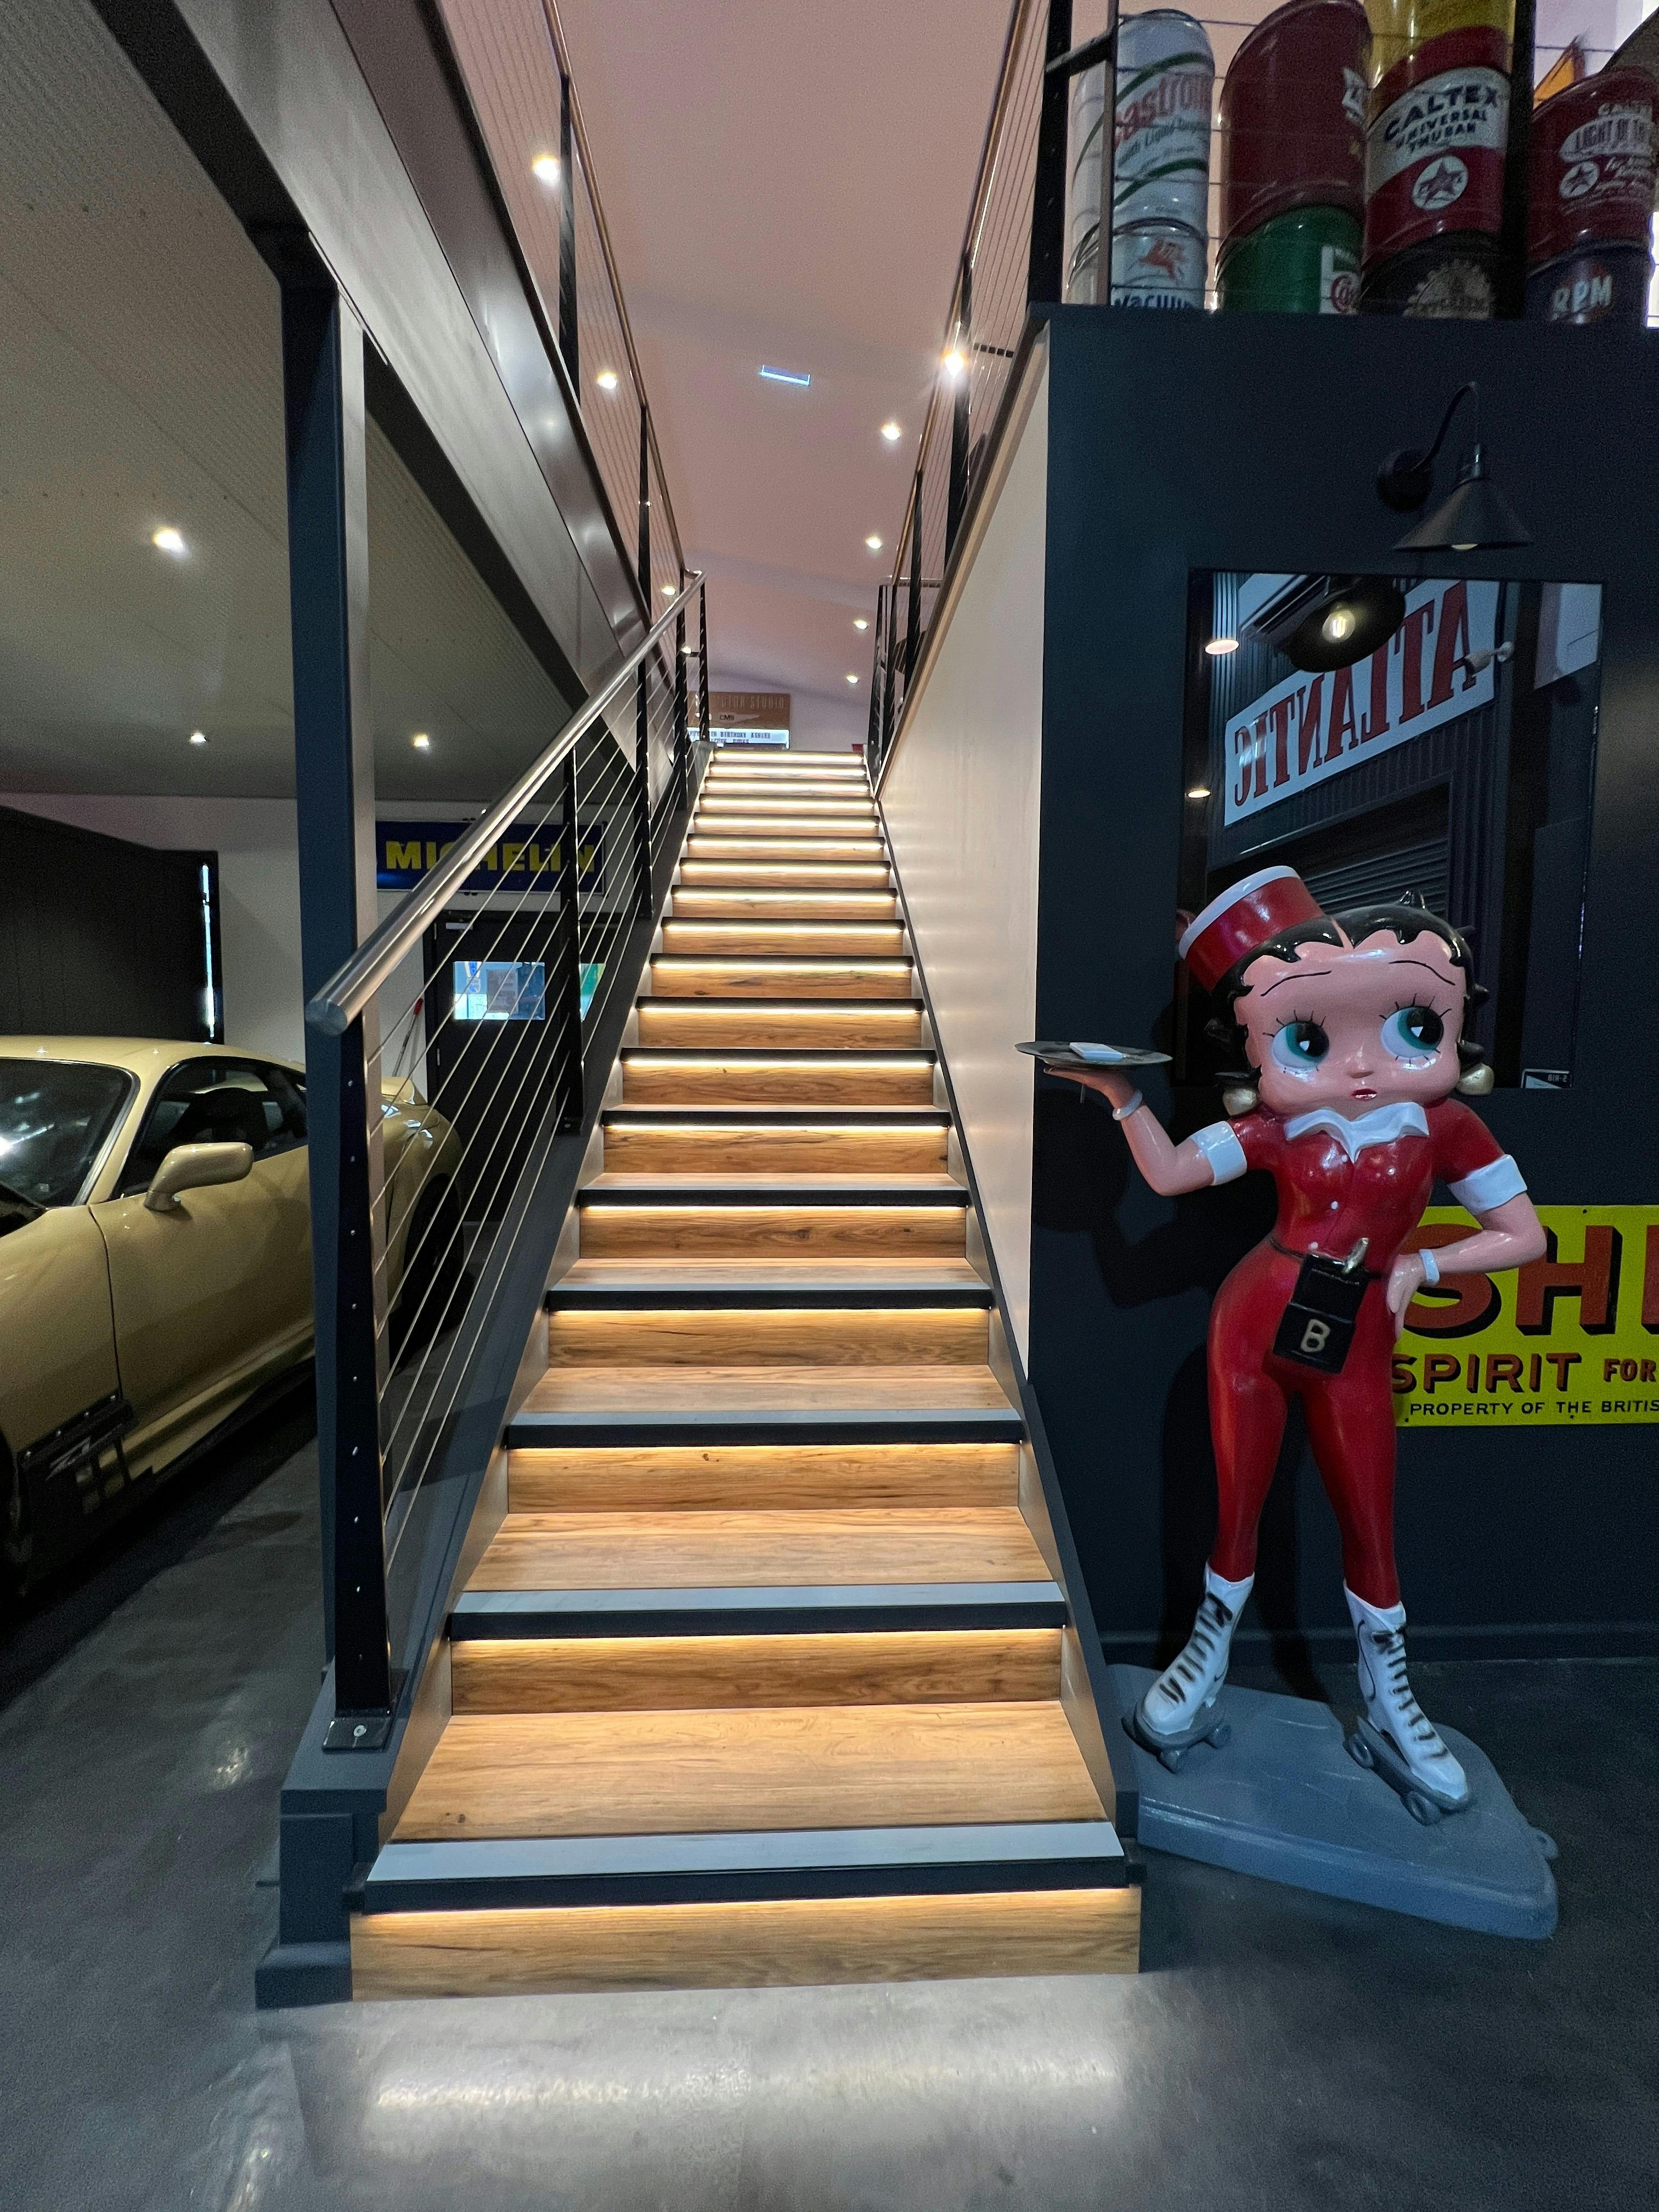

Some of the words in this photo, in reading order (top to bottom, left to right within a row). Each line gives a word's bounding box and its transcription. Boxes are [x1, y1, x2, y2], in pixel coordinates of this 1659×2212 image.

[1384, 84, 1498, 142] CALTEX
[1396, 109, 1487, 149] UNIVERSAL
[1552, 275, 1612, 312] RPM
[386, 840, 595, 873] MIHELIN
[1300, 1318, 1330, 1352] B
[1392, 1352, 1582, 1393] SPIRIT
[1603, 1358, 1657, 1382] FOR
[1410, 1402, 1513, 1415] PROPERTY
[1521, 1402, 1545, 1414] OF
[1556, 1401, 1591, 1413] THE
[1601, 1400, 1659, 1413] BRITIS
